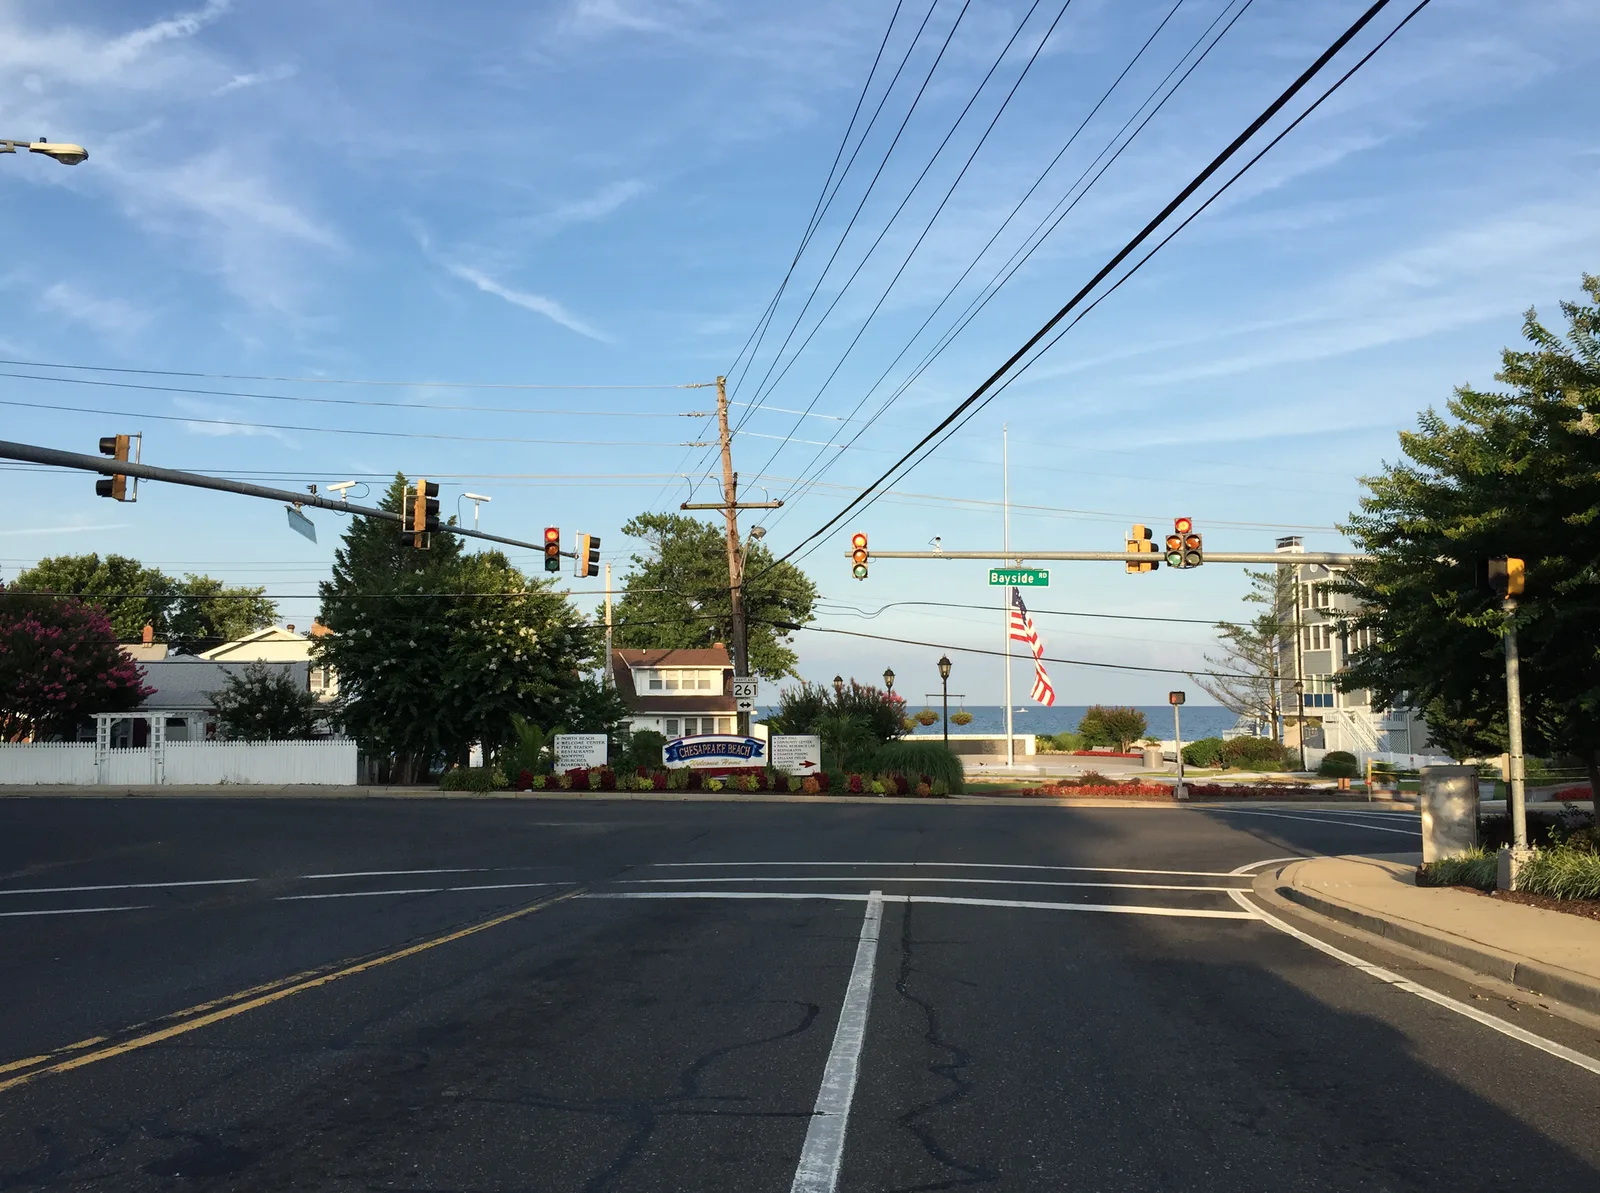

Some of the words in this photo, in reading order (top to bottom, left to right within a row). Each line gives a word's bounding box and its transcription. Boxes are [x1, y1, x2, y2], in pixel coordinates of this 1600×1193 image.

[991, 572, 1034, 585] Bayside
[734, 684, 756, 696] 261
[679, 744, 726, 758] CHESAPEAKE
[728, 744, 751, 756] BEACH
